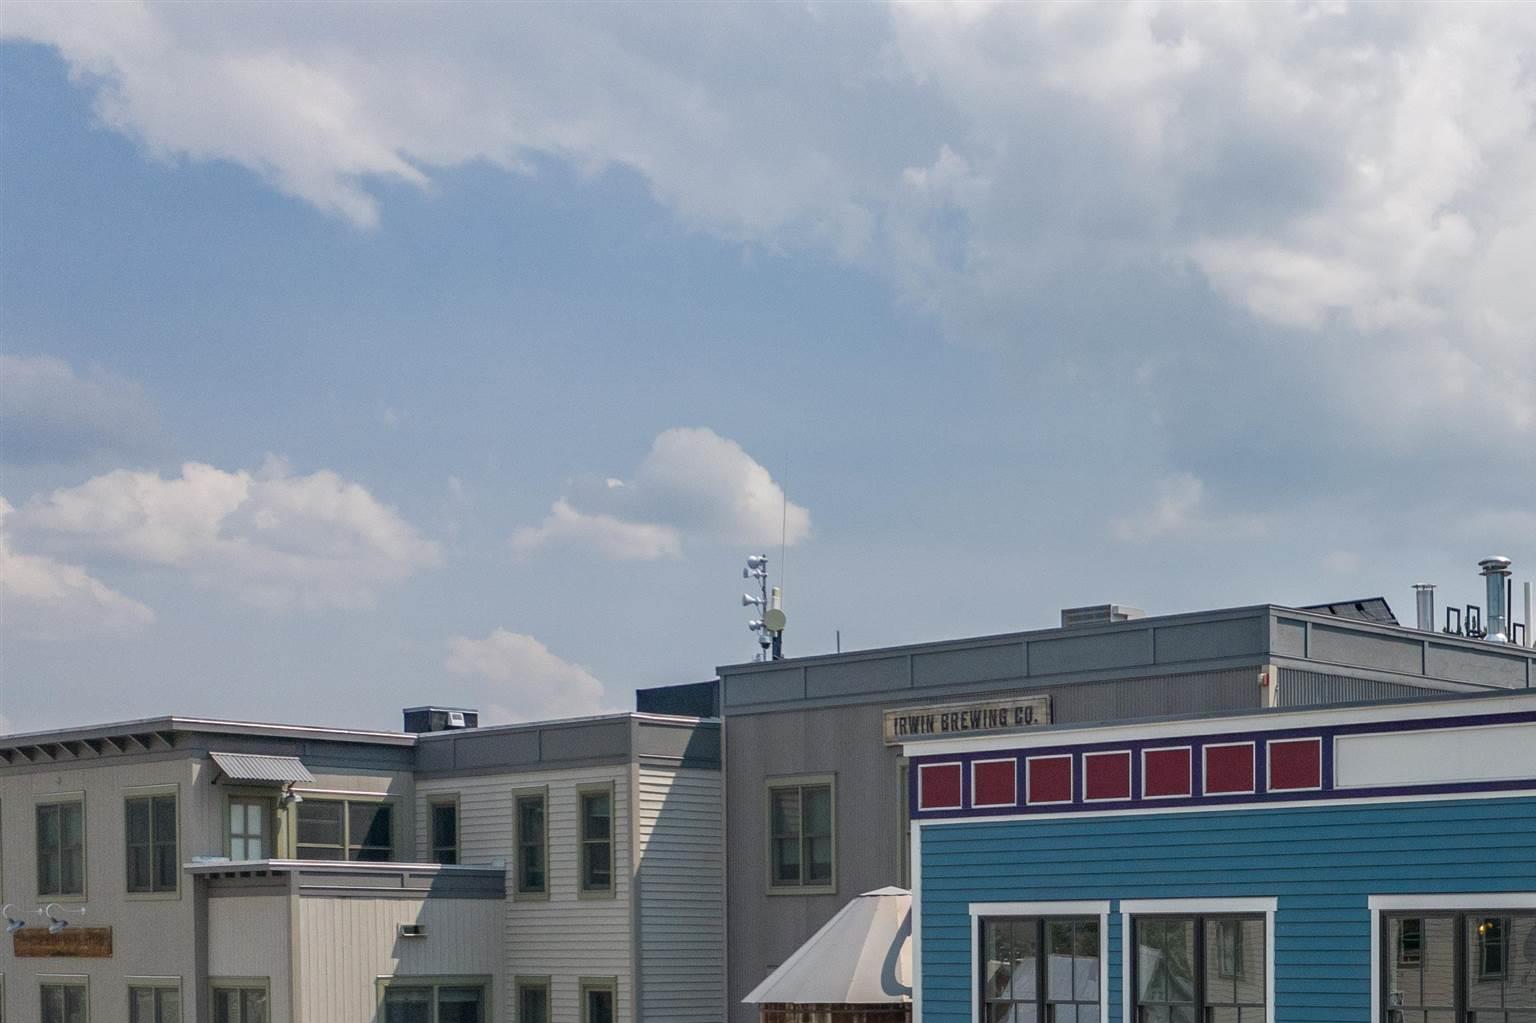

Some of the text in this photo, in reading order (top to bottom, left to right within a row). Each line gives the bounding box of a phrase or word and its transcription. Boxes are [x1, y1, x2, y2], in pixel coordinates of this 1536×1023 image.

[894, 705, 1039, 736] IRWIN BREWING CO.
